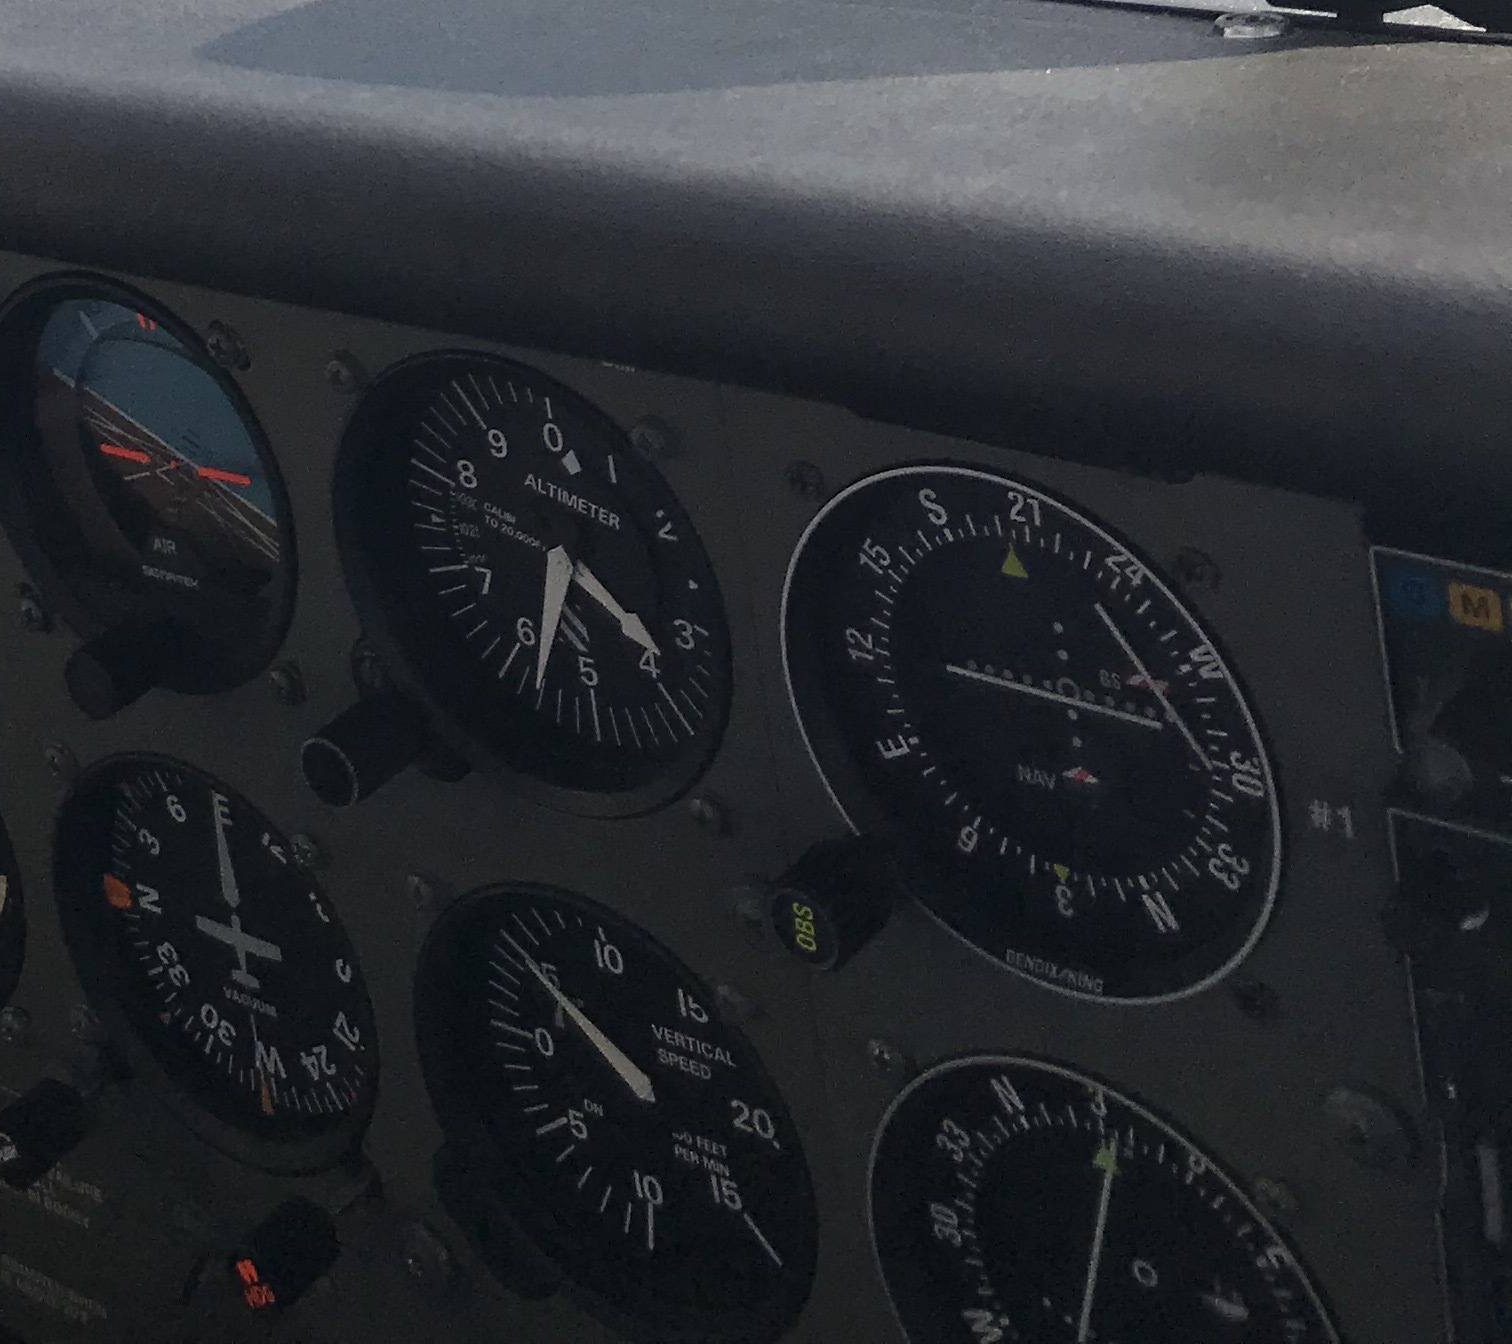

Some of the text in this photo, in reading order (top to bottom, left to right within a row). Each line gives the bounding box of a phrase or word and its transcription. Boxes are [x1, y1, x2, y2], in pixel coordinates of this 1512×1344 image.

[488, 428, 509, 459] 9
[542, 421, 564, 453] 0
[457, 459, 479, 490] 8
[523, 471, 623, 531] ALTIMETER
[917, 486, 949, 527] S
[1006, 489, 1043, 527] 21
[485, 514, 499, 529] TO
[858, 537, 891, 576] 15
[1103, 550, 1146, 588] 24
[474, 564, 493, 596] 7
[1461, 592, 1490, 618] M
[516, 616, 536, 647] 6
[672, 617, 696, 651] 3
[845, 625, 876, 662] 12
[577, 654, 600, 687] 5
[639, 648, 662, 680] 4
[1188, 644, 1226, 681] W
[876, 733, 912, 761] E
[1014, 763, 1059, 792] NAV
[1228, 750, 1266, 800] 30
[165, 793, 188, 824] 6
[212, 792, 234, 827] E
[138, 828, 161, 857] 3
[1206, 843, 1252, 893] 33
[135, 880, 164, 914] N
[1054, 886, 1075, 920] 3
[1141, 889, 1182, 936] N
[792, 902, 817, 951] OBS
[155, 940, 191, 988] 33
[593, 938, 624, 976] 10
[676, 987, 710, 1025] 15
[199, 1002, 237, 1048] 30
[534, 1027, 556, 1058] 0
[255, 1040, 288, 1080] W
[299, 1044, 337, 1082] 24
[650, 1023, 738, 1069] VERTICAL
[656, 1047, 713, 1081] SPEED
[989, 1074, 1027, 1114] N
[566, 1109, 589, 1141] 5
[729, 1098, 775, 1140] 20
[696, 1136, 728, 1160] FEET
[934, 1116, 972, 1165] 33
[632, 1169, 664, 1206] 10
[710, 1174, 743, 1210] 15
[928, 1201, 963, 1249] 30
